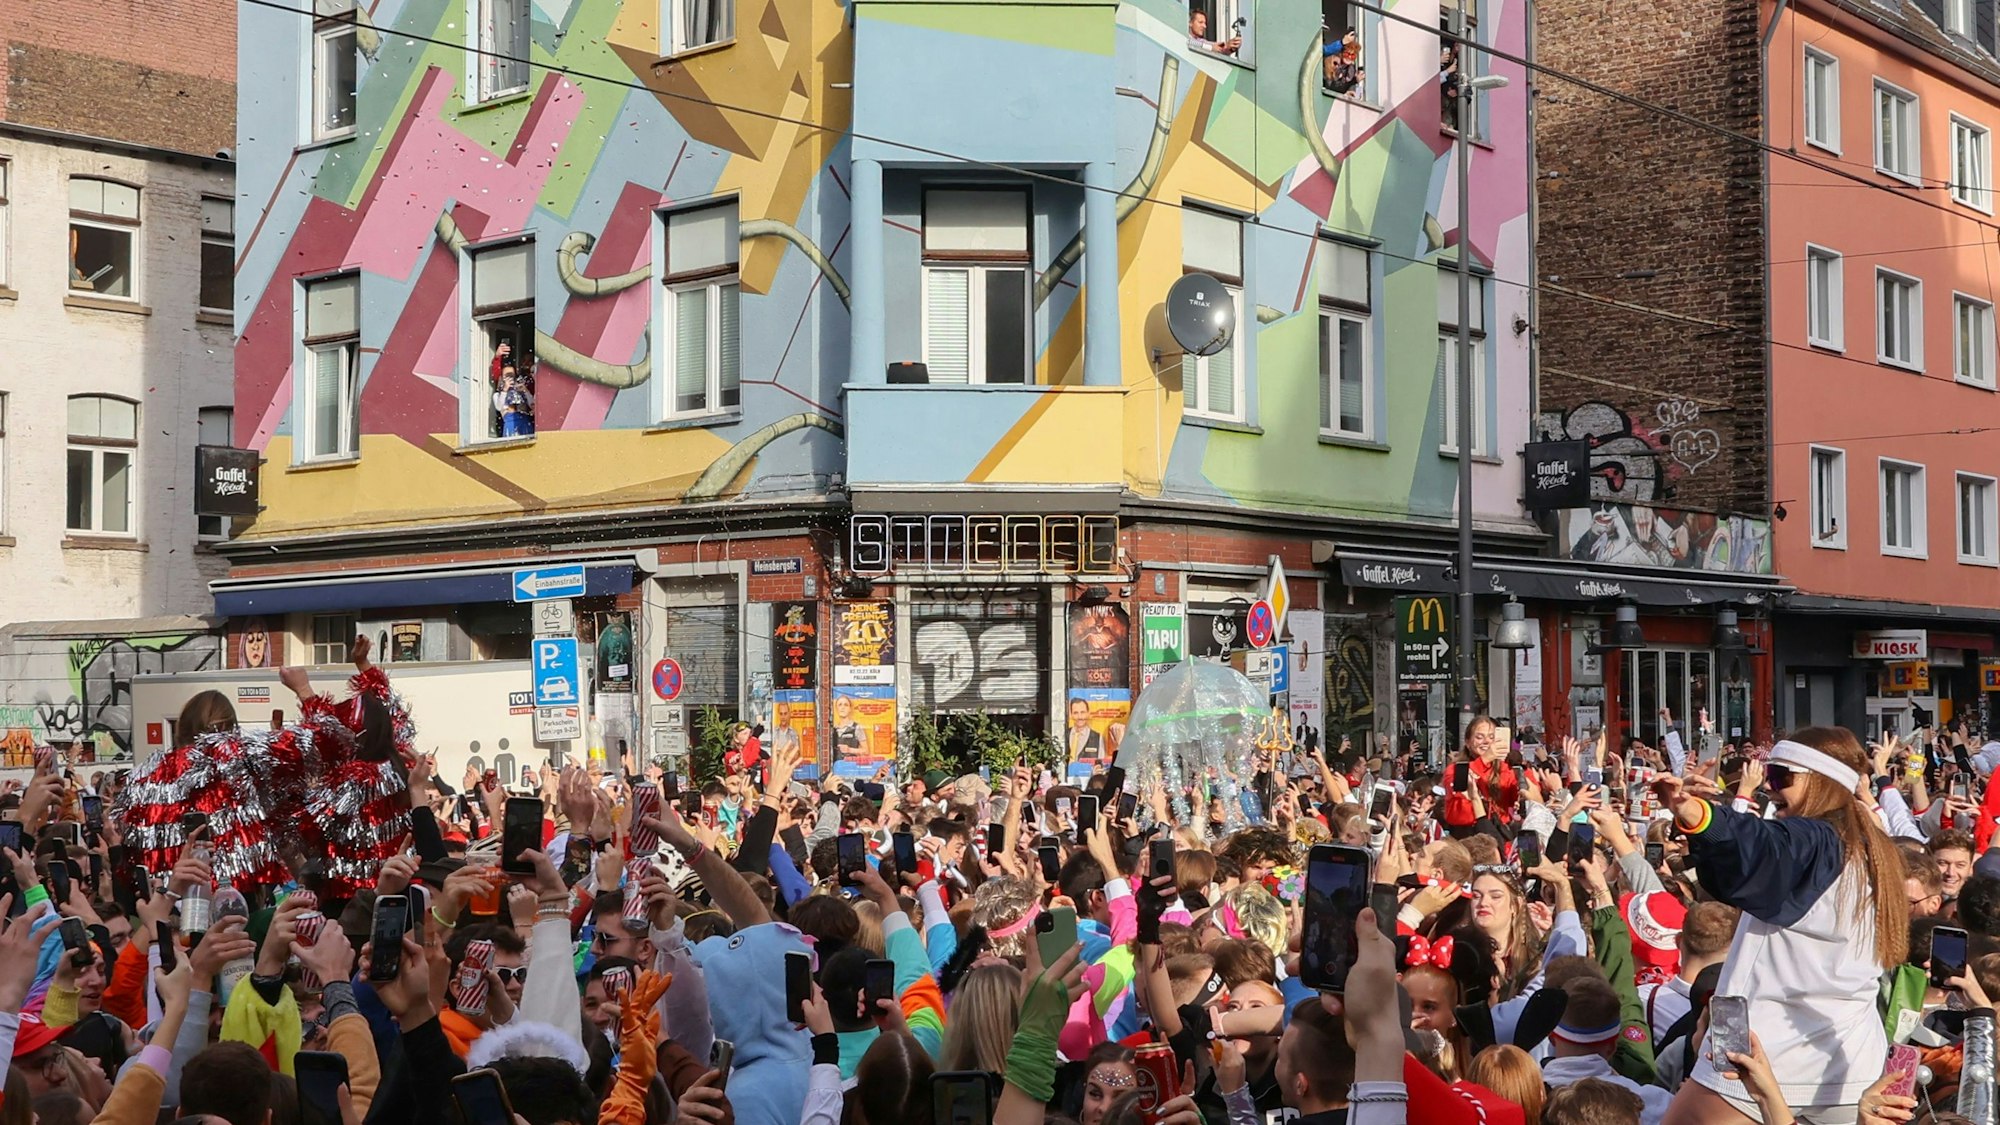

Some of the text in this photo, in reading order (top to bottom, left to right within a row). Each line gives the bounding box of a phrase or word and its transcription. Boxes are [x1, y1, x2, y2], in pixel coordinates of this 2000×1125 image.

[1188, 299, 1211, 307] TRIAX
[215, 466, 247, 482] Gaffel
[1536, 460, 1569, 475] Gaffel
[214, 481, 247, 496] Kölsch
[1536, 473, 1569, 490] Kölsch
[857, 522, 1113, 565] STIEFEL
[754, 559, 797, 574] Heinsbergstr.
[1362, 564, 1416, 585] Gaffel Kölsch
[535, 576, 581, 589] Einbahnstraße
[1579, 580, 1602, 597] Gaffel
[849, 603, 881, 613] DEINE
[1145, 605, 1165, 615] READY
[1167, 605, 1176, 615] TO
[841, 611, 889, 622] FREUNDE
[1146, 629, 1179, 650] TABU
[1403, 643, 1412, 651] in
[1412, 643, 1423, 651] 50
[1874, 642, 1919, 655] KIOSK
[1406, 653, 1431, 661] rechts
[510, 692, 528, 705] TOI
